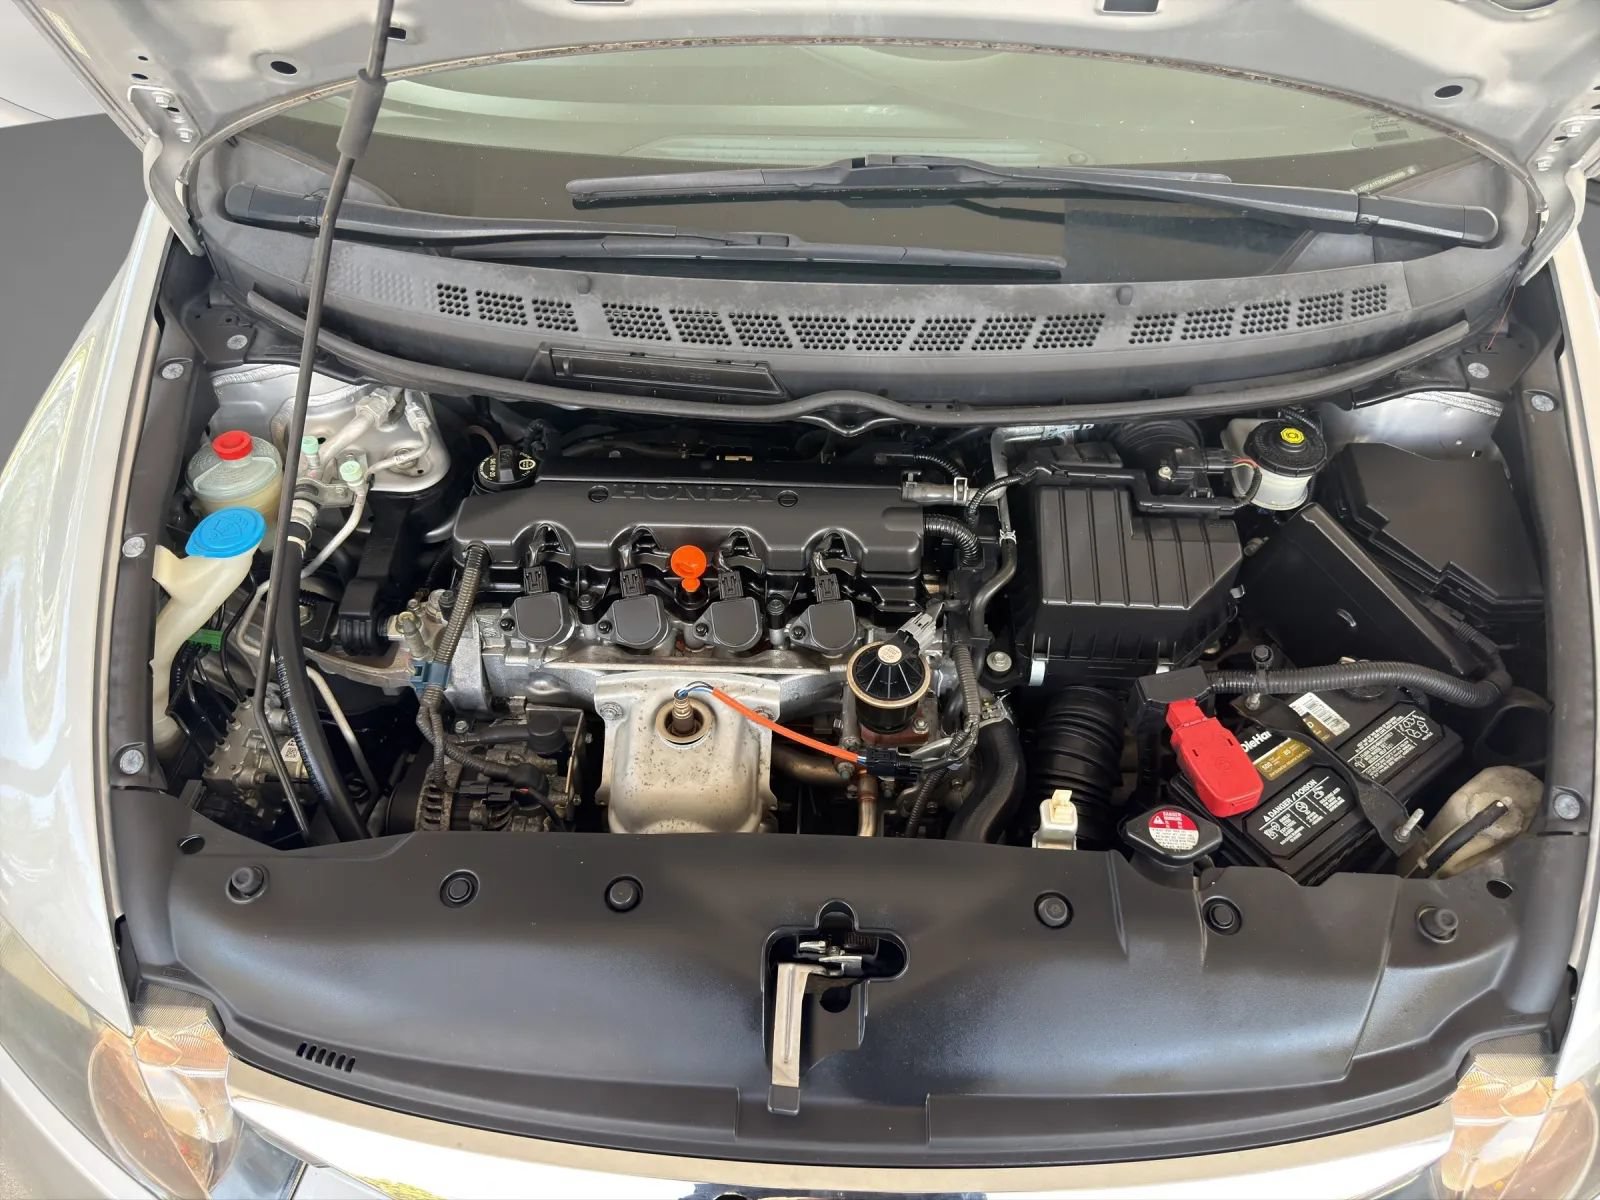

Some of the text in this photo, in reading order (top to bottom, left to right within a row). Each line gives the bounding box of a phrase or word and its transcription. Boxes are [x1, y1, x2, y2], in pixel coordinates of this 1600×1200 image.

[610, 483, 776, 503] HONDA
[1267, 797, 1292, 817] DANGER
[1295, 779, 1317, 797] POISON
